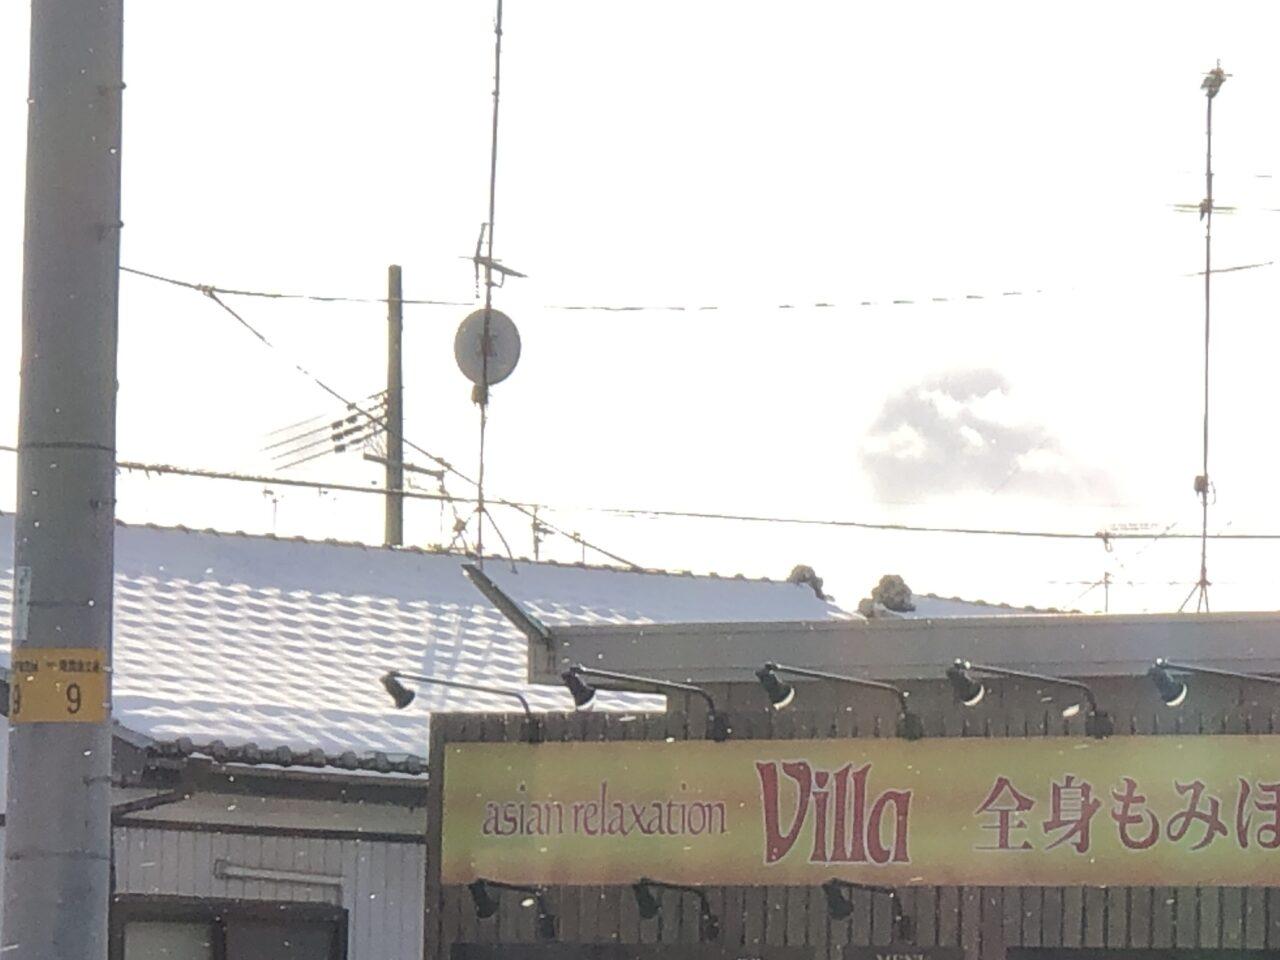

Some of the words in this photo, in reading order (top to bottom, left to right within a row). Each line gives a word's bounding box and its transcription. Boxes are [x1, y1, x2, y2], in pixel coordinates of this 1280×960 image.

[66, 683, 81, 714] 9
[482, 782, 564, 836] asian
[571, 780, 728, 837] relaxation
[755, 760, 912, 864] Villa
